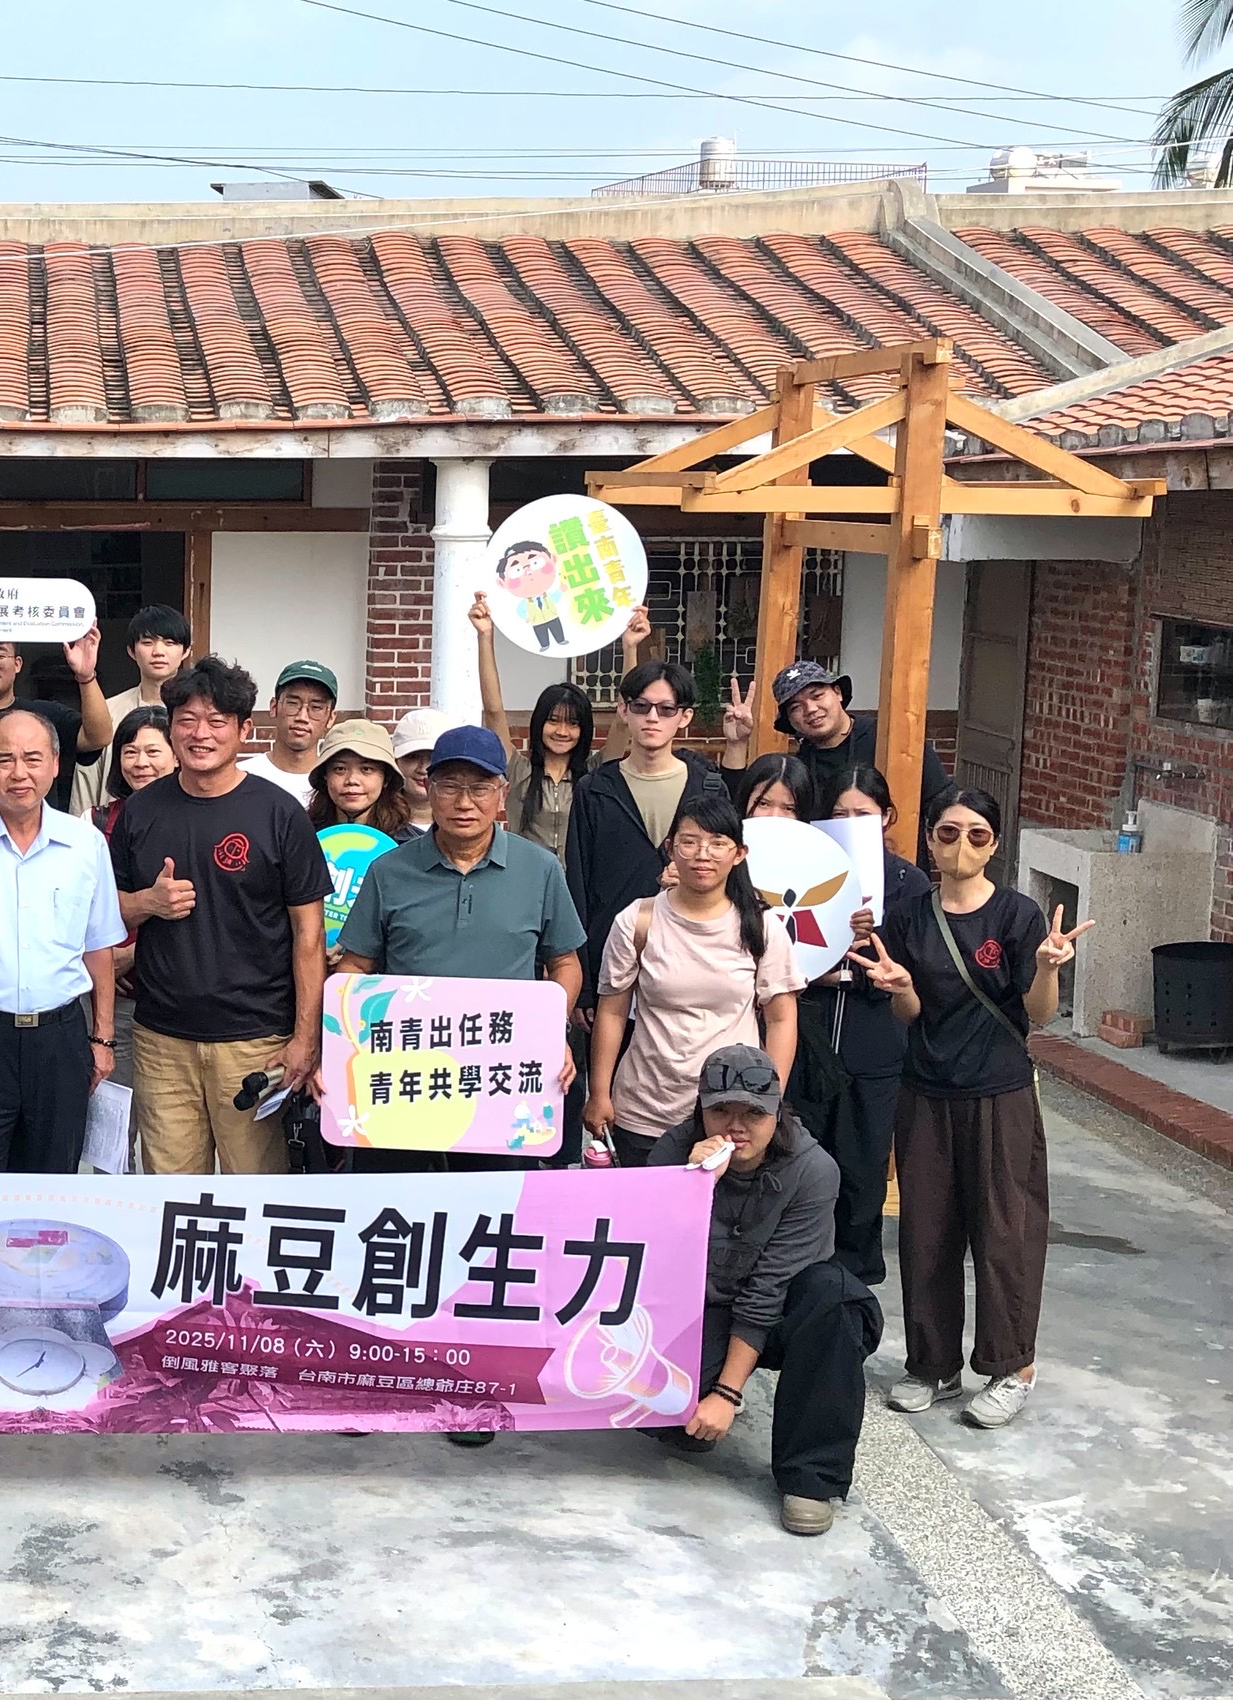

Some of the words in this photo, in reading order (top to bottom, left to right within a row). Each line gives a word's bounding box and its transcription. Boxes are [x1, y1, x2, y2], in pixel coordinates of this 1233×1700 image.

[549, 516, 614, 625] 讚出來
[586, 509, 636, 607] 臺南青年
[370, 1010, 513, 1054] 南青出任務
[369, 1060, 543, 1105] 青年共學交流
[150, 1193, 645, 1326] 麻豆創生力
[161, 1355, 279, 1379] 倒風雅客聚落
[298, 1368, 516, 1396] 台南市麻豆區總爺庄87-1
